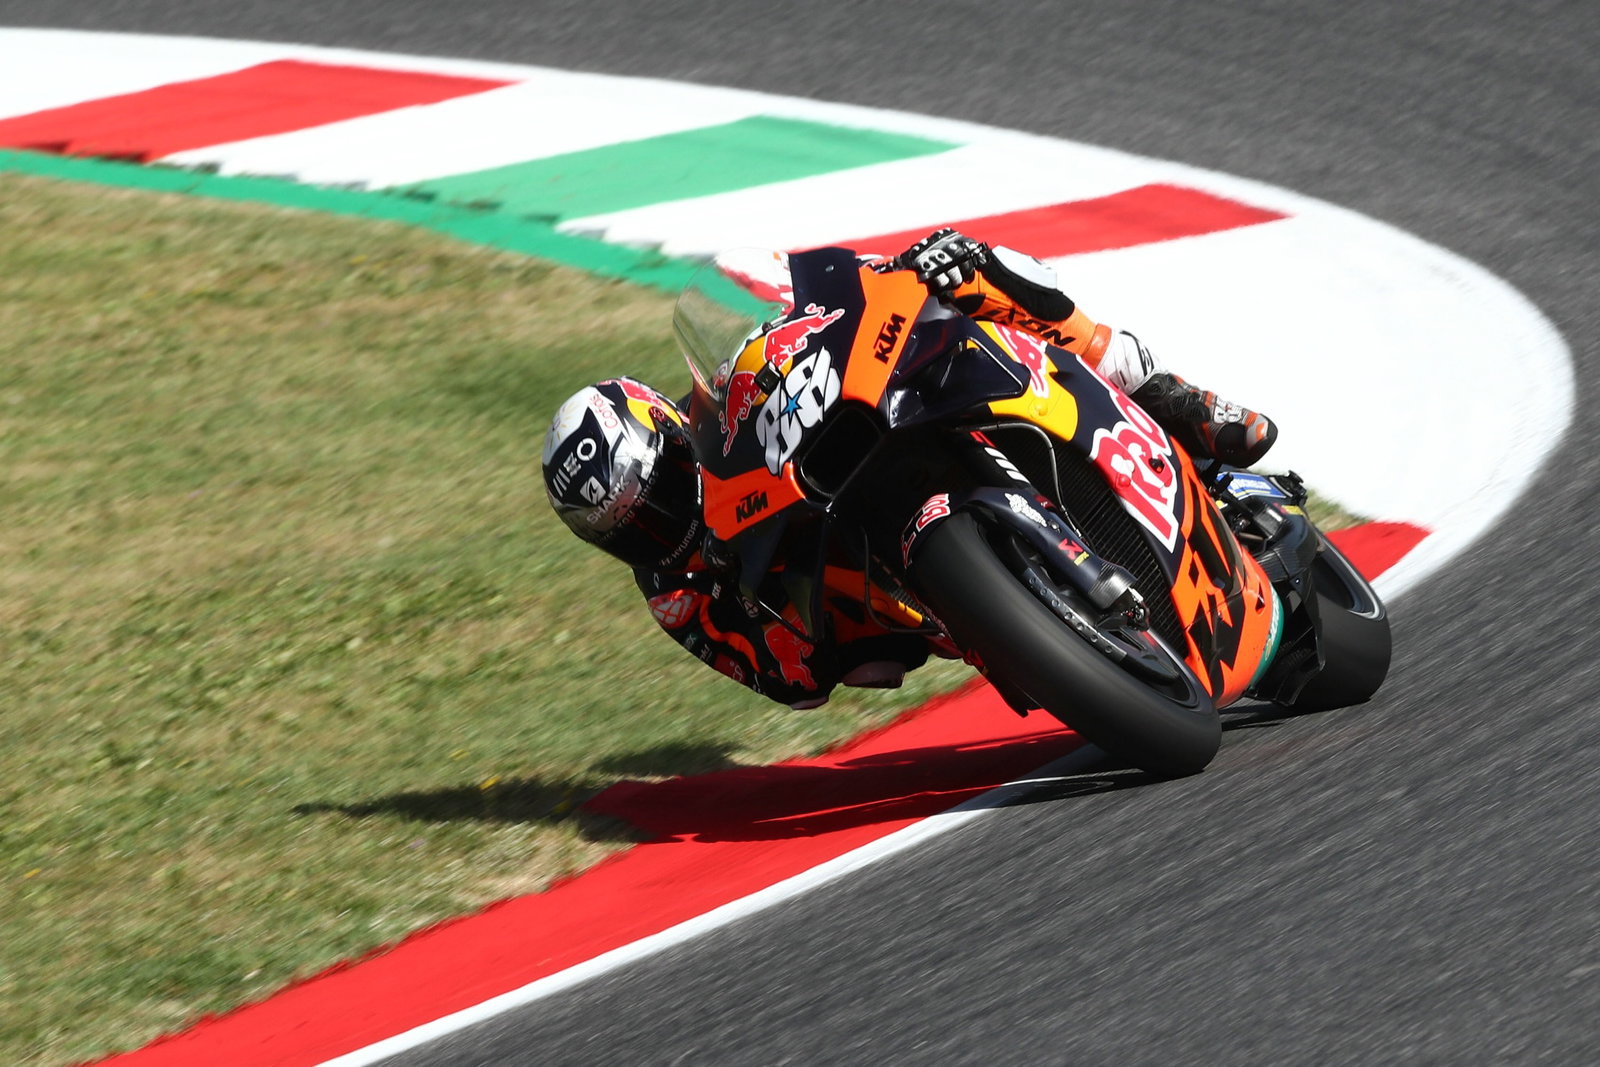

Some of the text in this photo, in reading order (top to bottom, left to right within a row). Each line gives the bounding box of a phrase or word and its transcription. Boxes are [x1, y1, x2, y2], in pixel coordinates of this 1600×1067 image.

[874, 312, 906, 364] KTM
[755, 346, 841, 479] 88
[586, 475, 632, 525] SHARK
[735, 489, 768, 524] KTM
